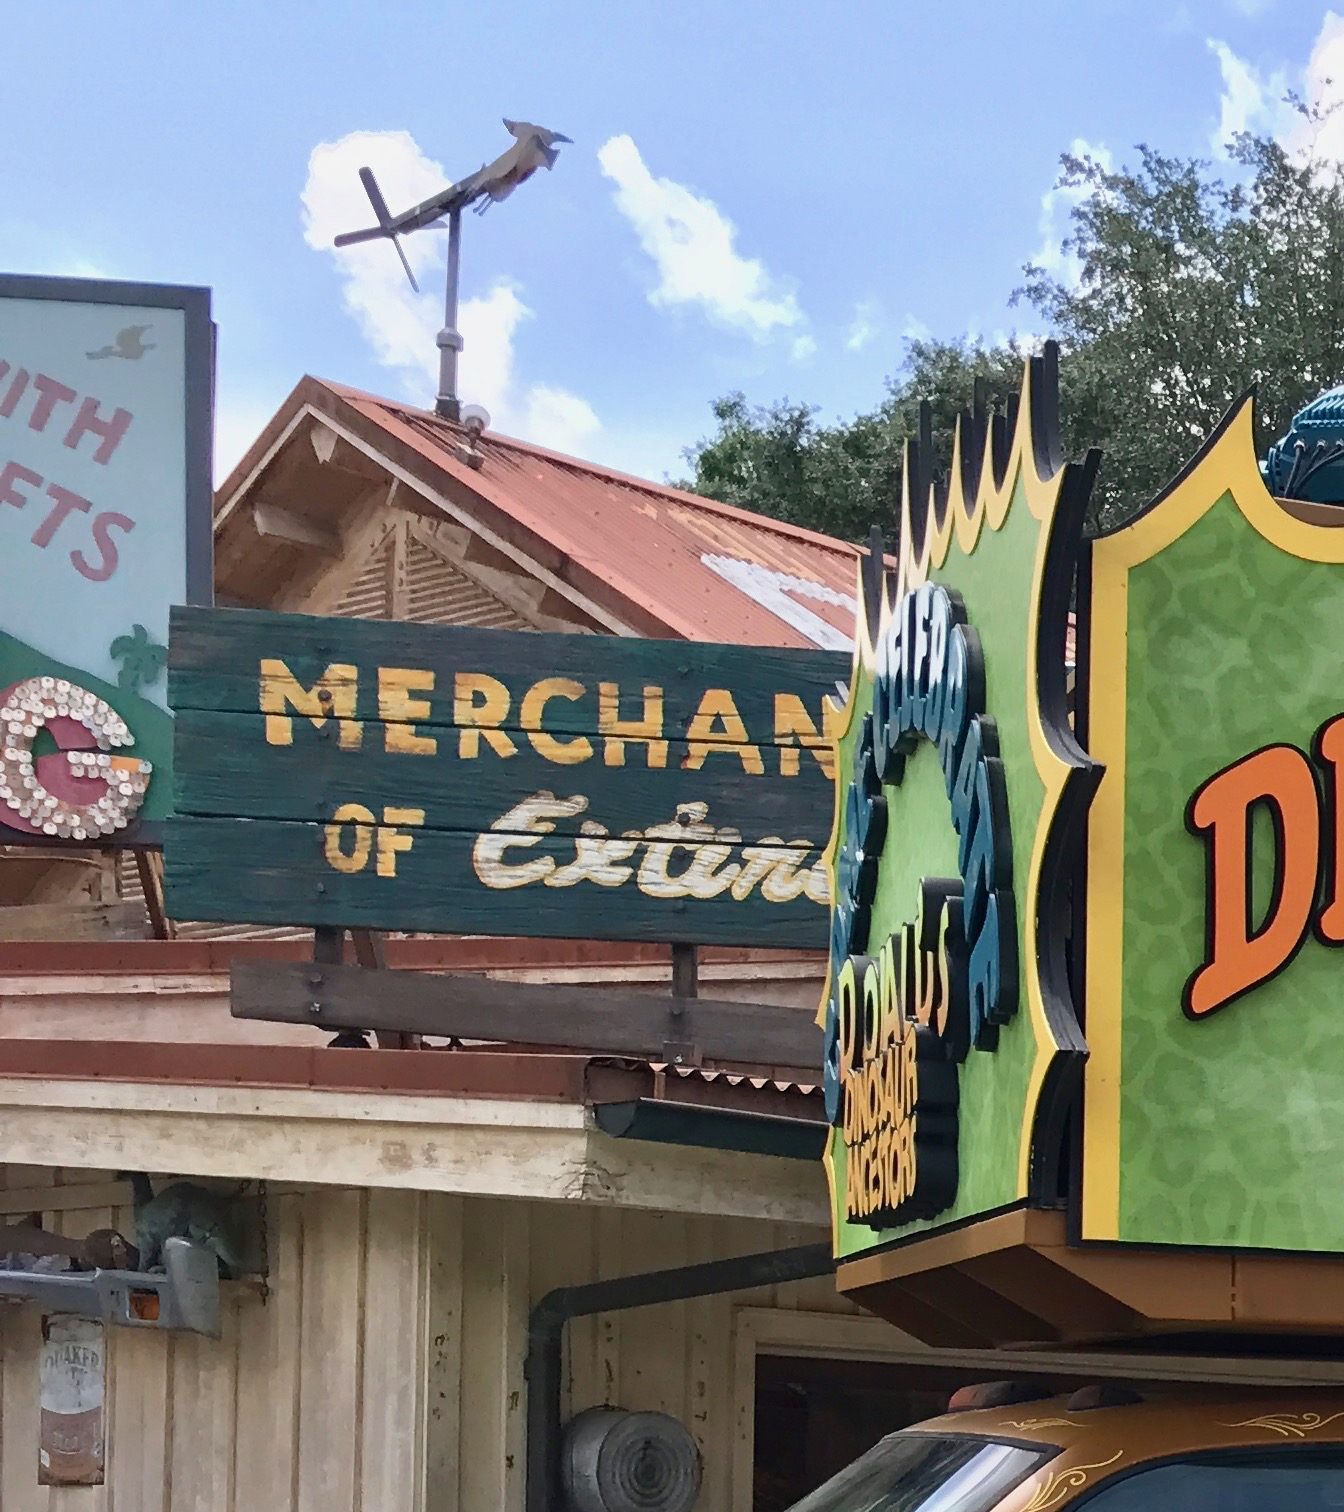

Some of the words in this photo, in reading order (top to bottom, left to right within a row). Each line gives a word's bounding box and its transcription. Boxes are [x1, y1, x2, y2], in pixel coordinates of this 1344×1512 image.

[0, 359, 134, 466] ITH
[258, 658, 837, 780] MERCHAN
[323, 803, 426, 877] OF
[843, 1024, 918, 1146] DINOSAUR
[845, 1112, 917, 1220] ANCESTORS
